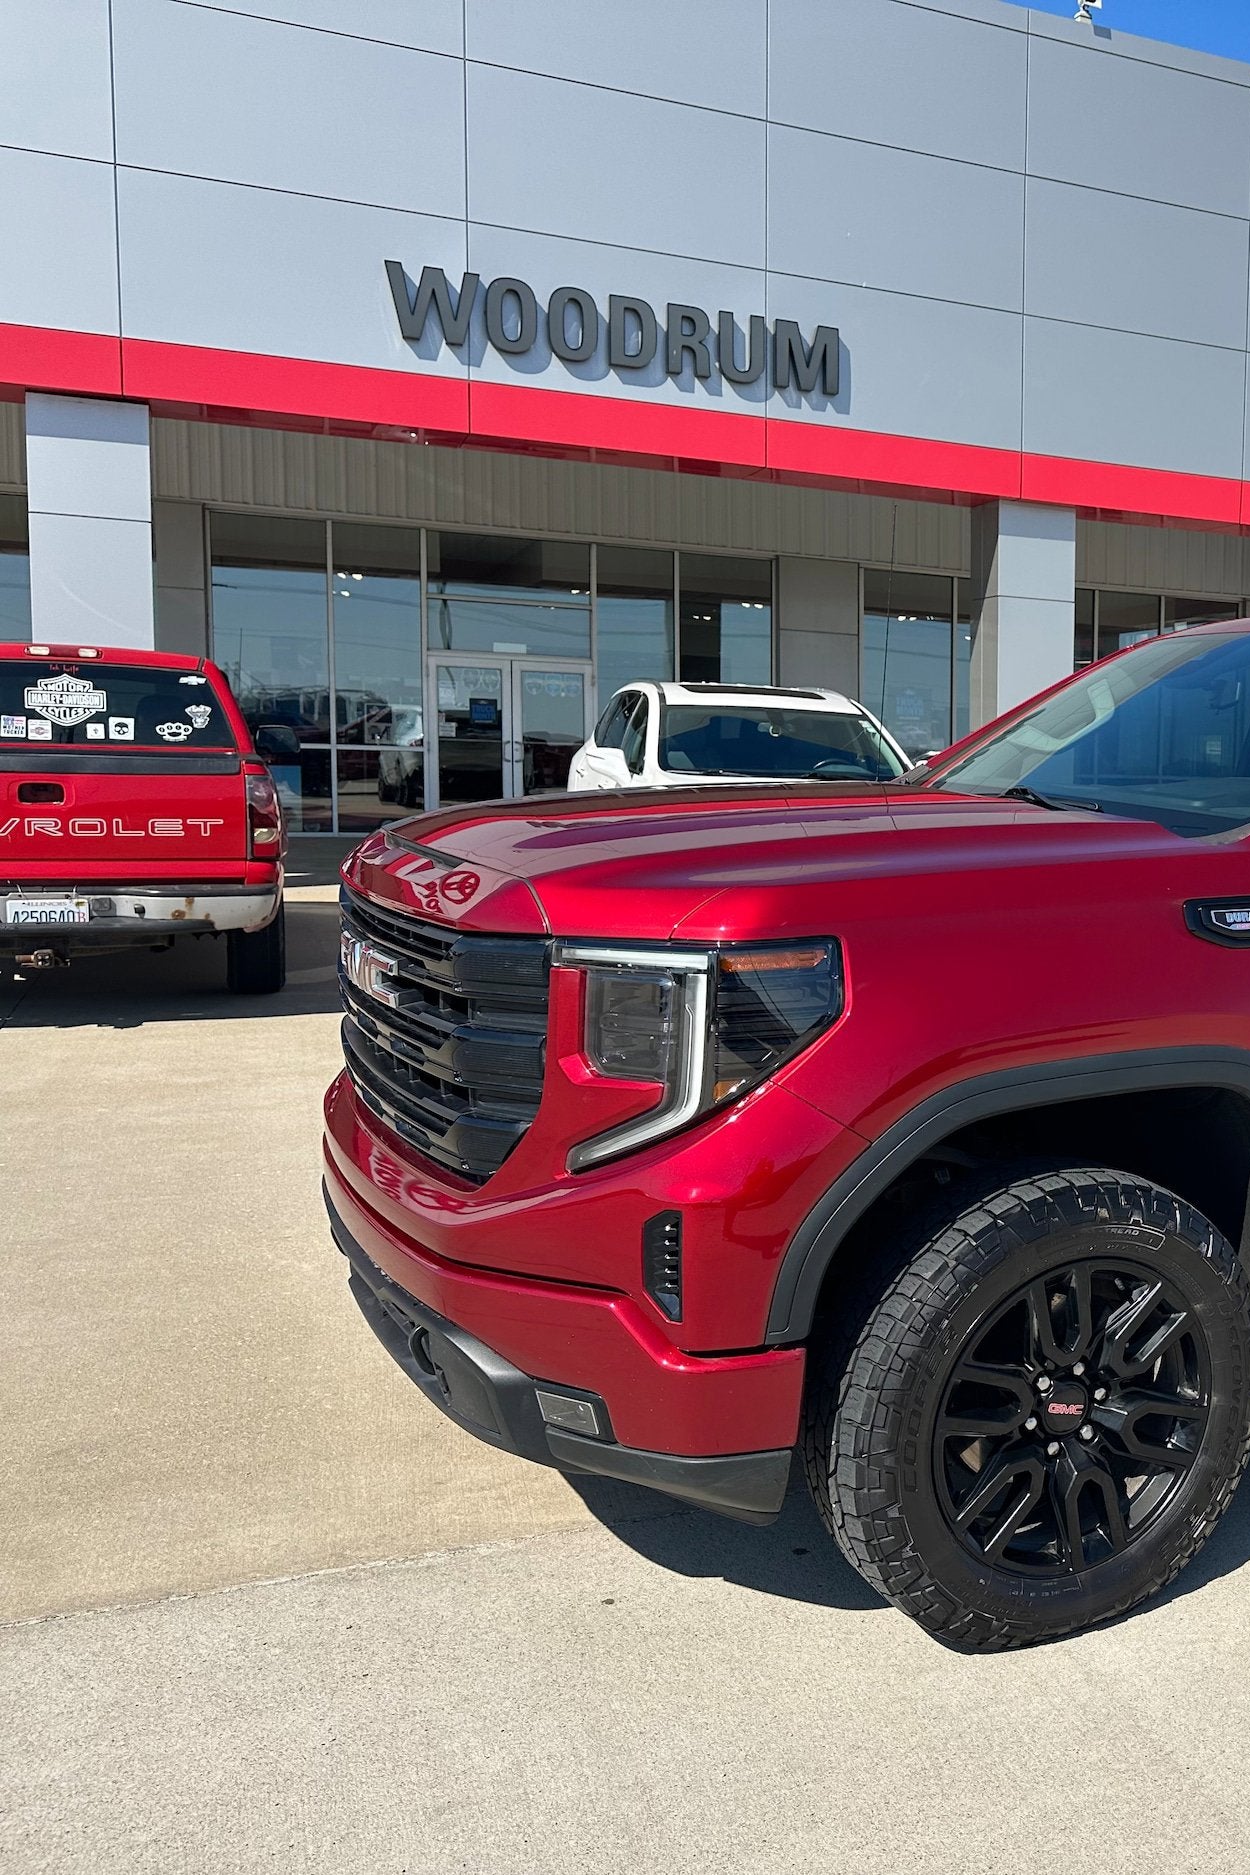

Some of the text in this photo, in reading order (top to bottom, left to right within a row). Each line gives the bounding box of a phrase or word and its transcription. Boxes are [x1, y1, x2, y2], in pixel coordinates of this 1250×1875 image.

[384, 259, 840, 396] WOODRUM
[46, 681, 84, 692] MOTOR
[31, 693, 100, 705] HARLEY-DAVIDSON
[47, 707, 85, 720] CYCLES
[1048, 1403, 1084, 1415] GMC
